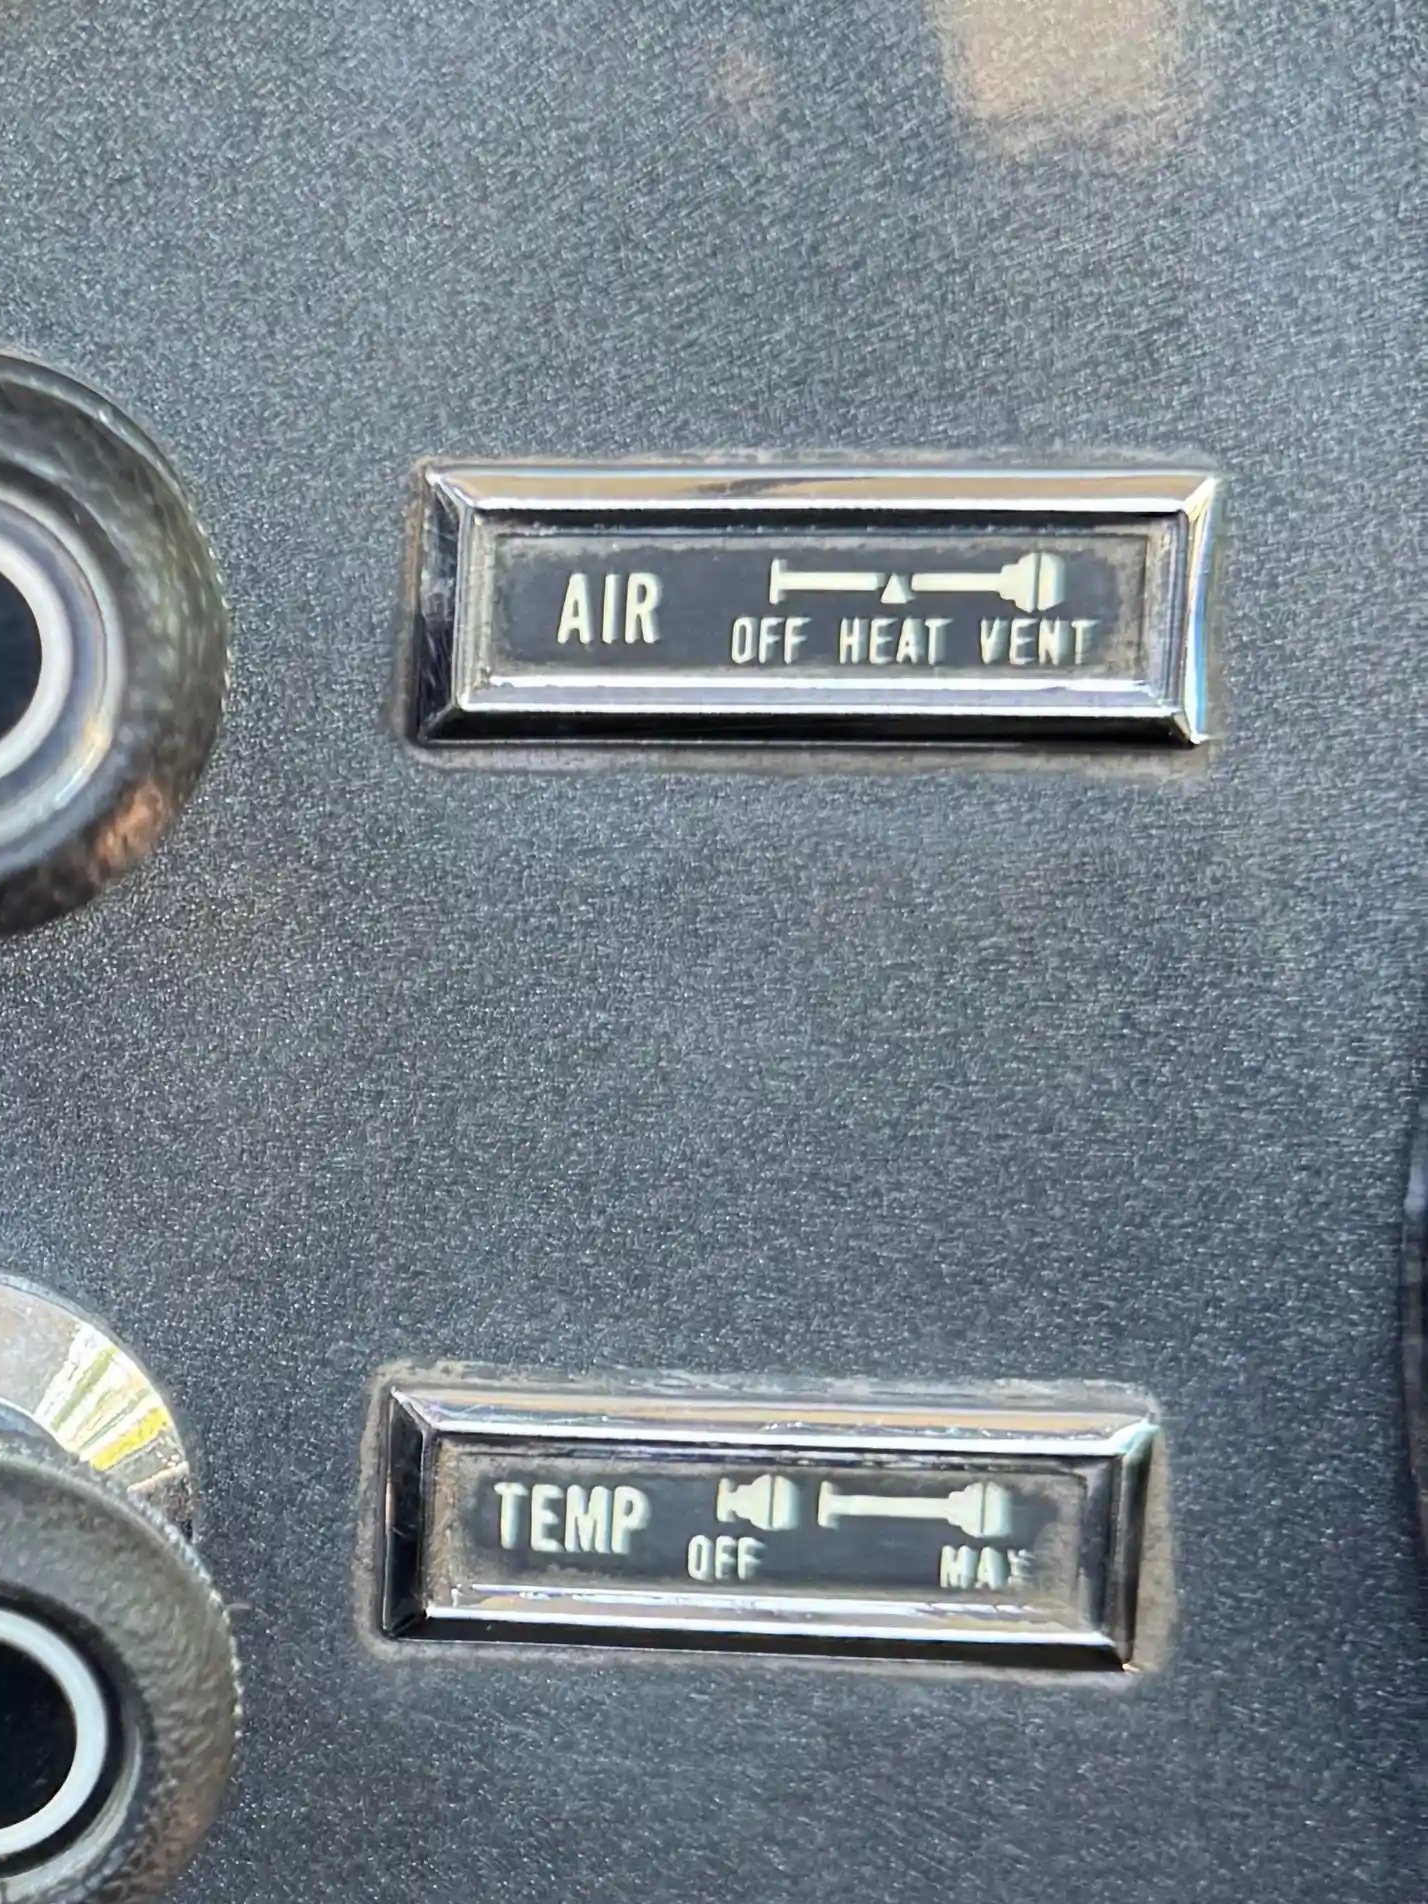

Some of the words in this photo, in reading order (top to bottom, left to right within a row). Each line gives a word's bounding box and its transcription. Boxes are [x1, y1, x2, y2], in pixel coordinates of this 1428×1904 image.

[555, 572, 662, 645] AIR
[731, 616, 807, 664] OFF
[838, 617, 947, 666] HEAT
[979, 618, 1096, 666] VENT
[494, 1482, 649, 1556] TEMP
[686, 1534, 767, 1582] OFF
[939, 1545, 1033, 1590] MAX
